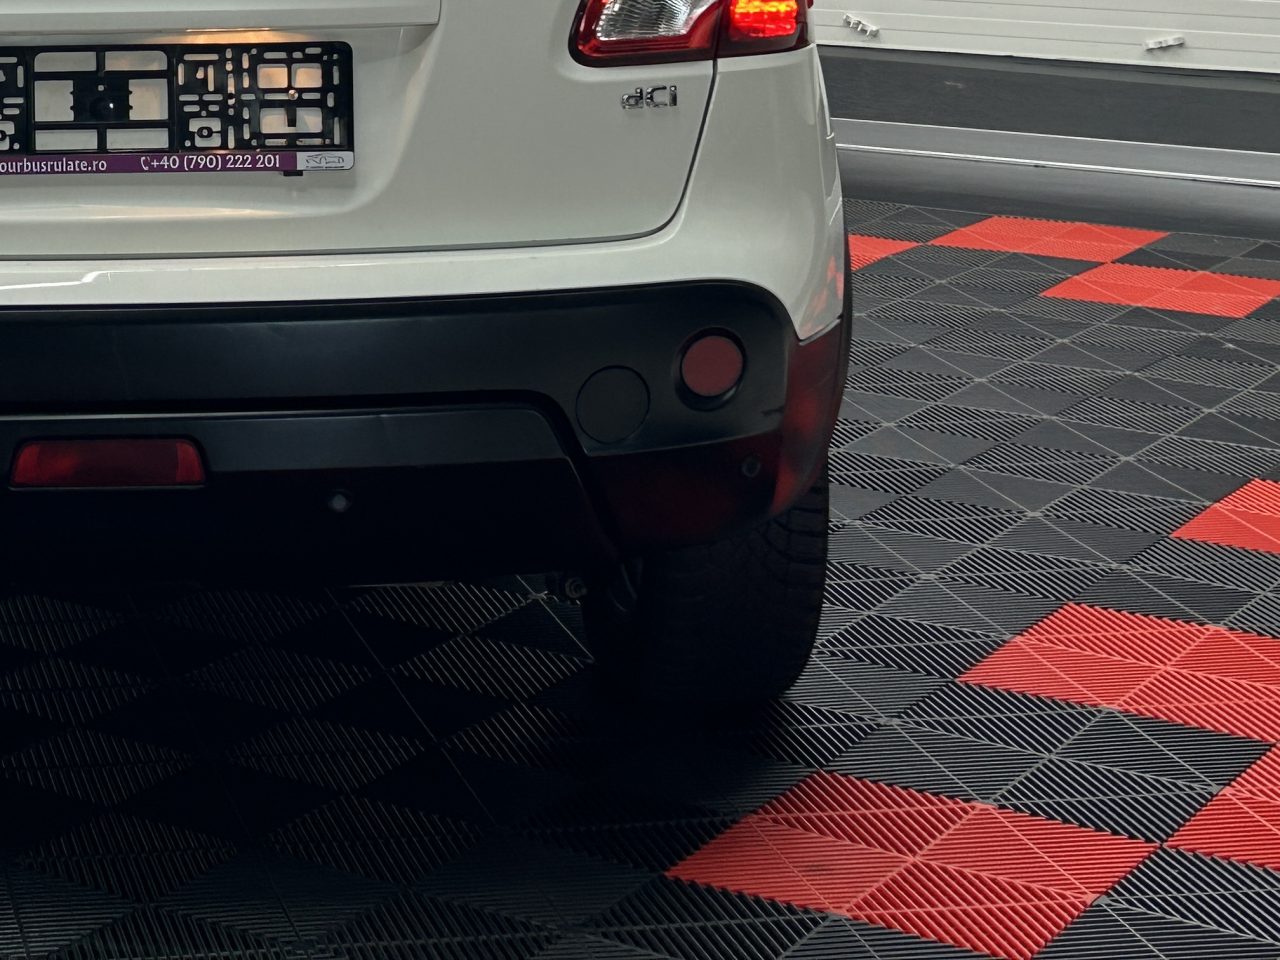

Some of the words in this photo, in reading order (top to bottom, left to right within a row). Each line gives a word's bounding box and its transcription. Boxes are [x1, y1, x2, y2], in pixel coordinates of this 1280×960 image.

[621, 85, 677, 109] dCi
[151, 156, 179, 169] +40
[184, 155, 221, 170] (790)
[226, 155, 252, 168] 222
[256, 155, 280, 168] 201
